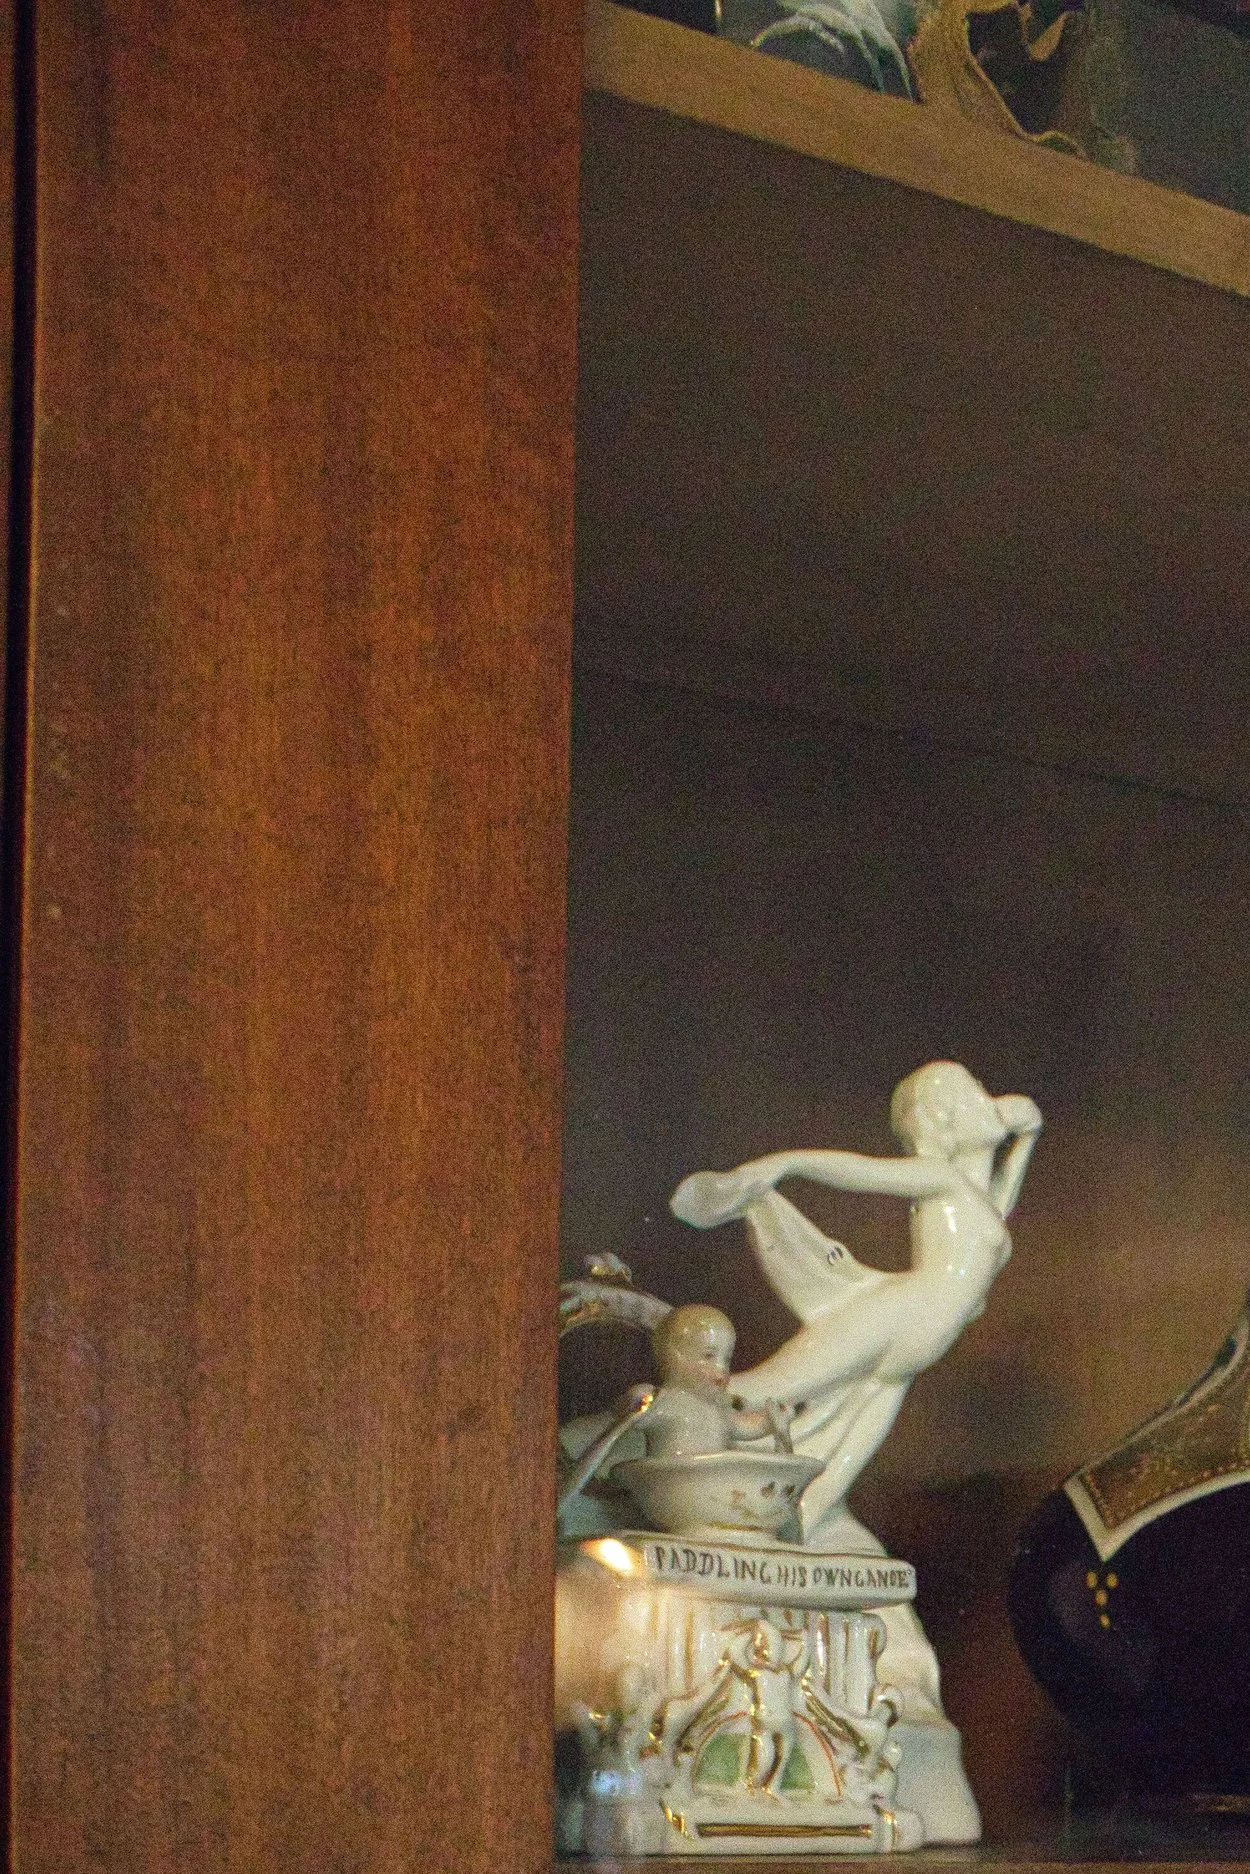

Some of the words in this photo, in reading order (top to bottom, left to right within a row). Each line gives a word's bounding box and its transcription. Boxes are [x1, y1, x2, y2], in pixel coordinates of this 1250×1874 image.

[654, 1545, 772, 1584] PADDLING
[777, 1565, 808, 1588] HIS
[812, 1566, 852, 1588] OWN
